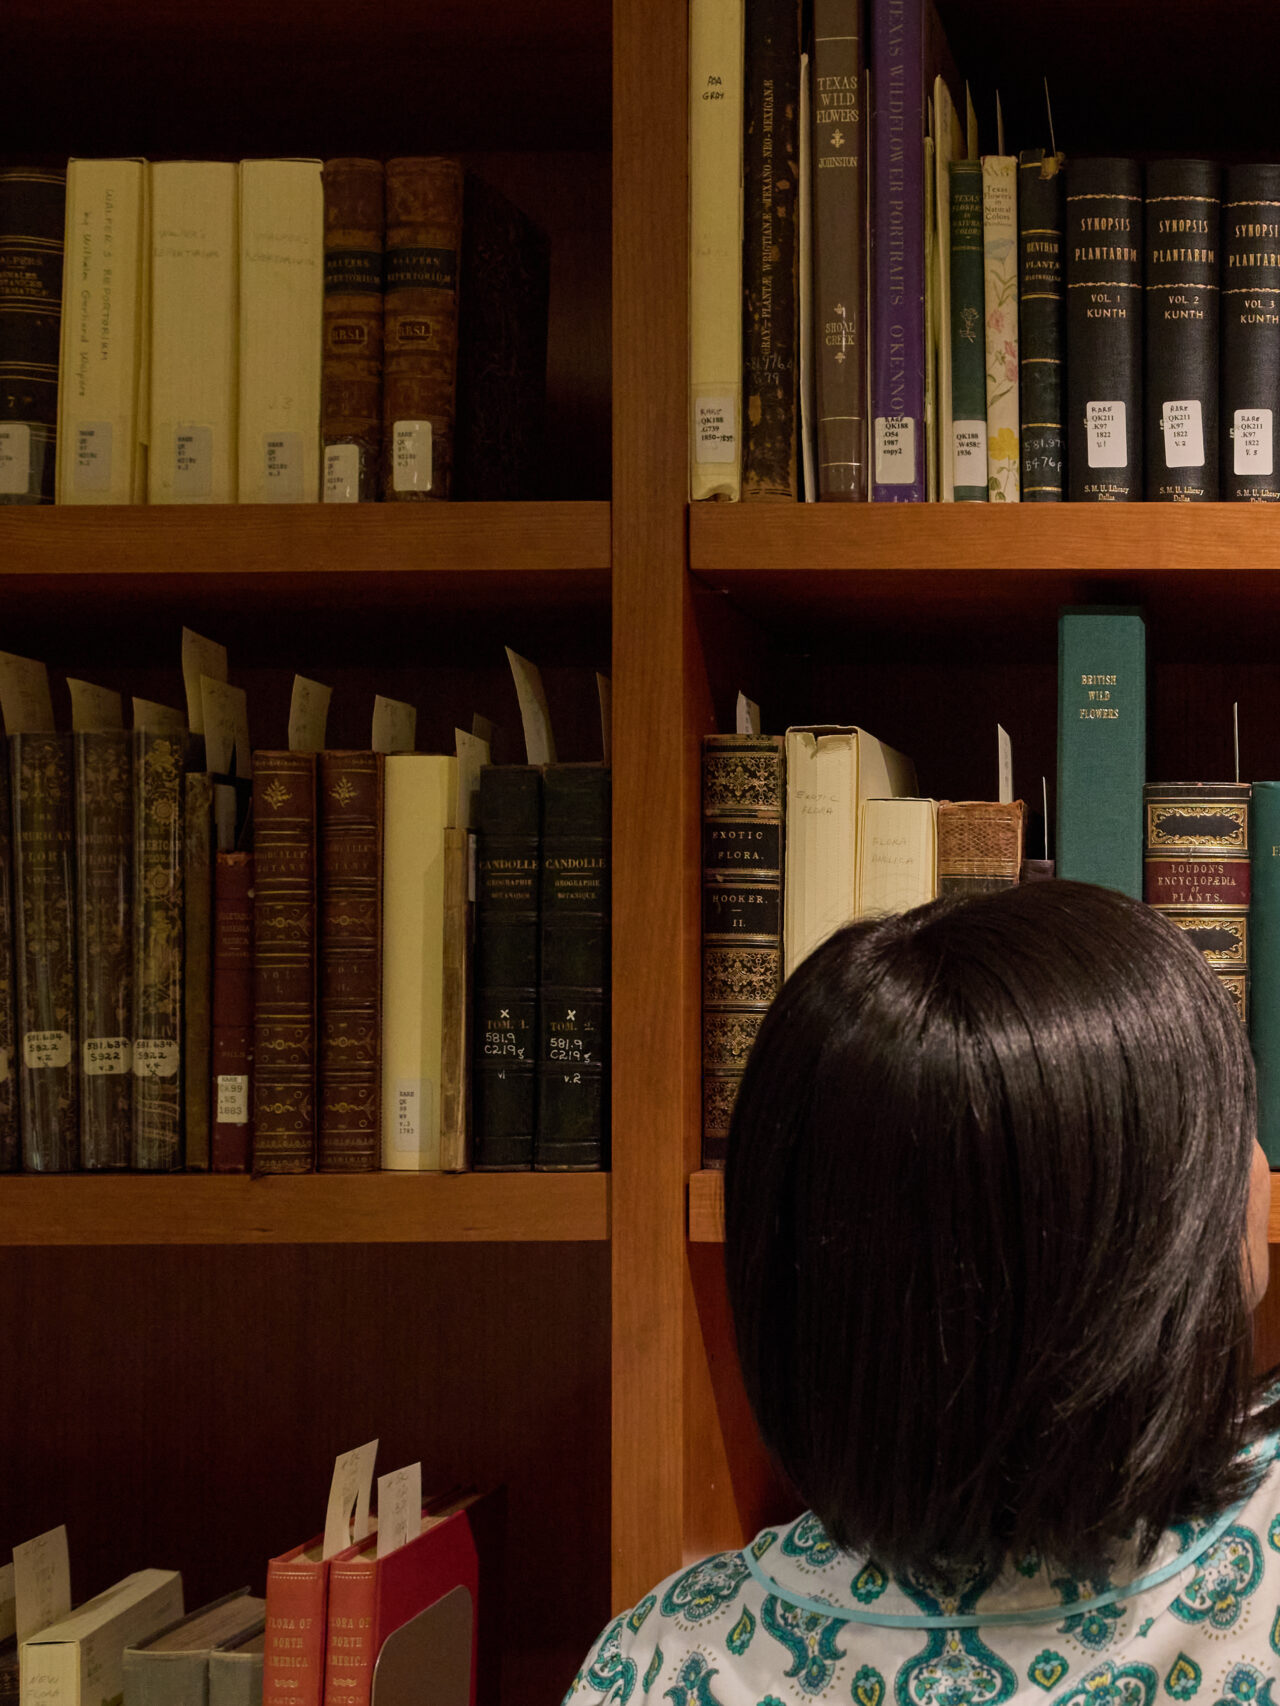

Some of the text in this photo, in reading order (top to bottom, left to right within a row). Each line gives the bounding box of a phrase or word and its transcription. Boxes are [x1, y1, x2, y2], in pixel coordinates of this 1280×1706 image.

[817, 77, 859, 91] TEXAS
[822, 92, 856, 106] WILD
[816, 108, 861, 123] FLOWERS
[889, 66, 906, 191] WILDFLOWER
[818, 156, 859, 169] JOHNSTON
[1081, 216, 1132, 233] SYNOPSIS
[1159, 219, 1209, 235] SYNOPSIS
[889, 201, 906, 306] PORTRAITS
[1074, 246, 1138, 263] PLANTARUM
[1153, 248, 1216, 265] PLANTARUM
[1087, 309, 1127, 320] KUNTH
[1164, 310, 1204, 320] KUNTH
[1240, 314, 1280, 324] KUNTH
[825, 321, 857, 335] SHOAL
[825, 335, 856, 347] CREEK
[701, 417, 725, 425] QK188
[1092, 415, 1115, 424] QK211
[1168, 413, 1192, 421] QK211
[885, 423, 909, 431] QK188
[1241, 423, 1264, 431] QK211
[956, 432, 980, 441] QK188
[1096, 432, 1112, 440] 1822
[883, 440, 899, 448] 1987
[957, 449, 973, 458] 1936
[1080, 674, 1118, 686] BRITISH
[1087, 690, 1112, 702] WILD
[1079, 707, 1120, 720] FLOWERS
[711, 830, 766, 841] EXOTIC
[719, 850, 767, 861] FLORA.
[545, 858, 607, 871] CANDOLLE
[1171, 864, 1225, 874] LOUDON'S
[710, 893, 770, 905] HOOKER.
[1172, 893, 1224, 903] PLANTS.
[485, 1032, 516, 1045] 581.9
[550, 1037, 583, 1051] 581.9
[90, 1051, 122, 1062] S922
[563, 1071, 582, 1084] v.2
[272, 1636, 304, 1649] NORTH
